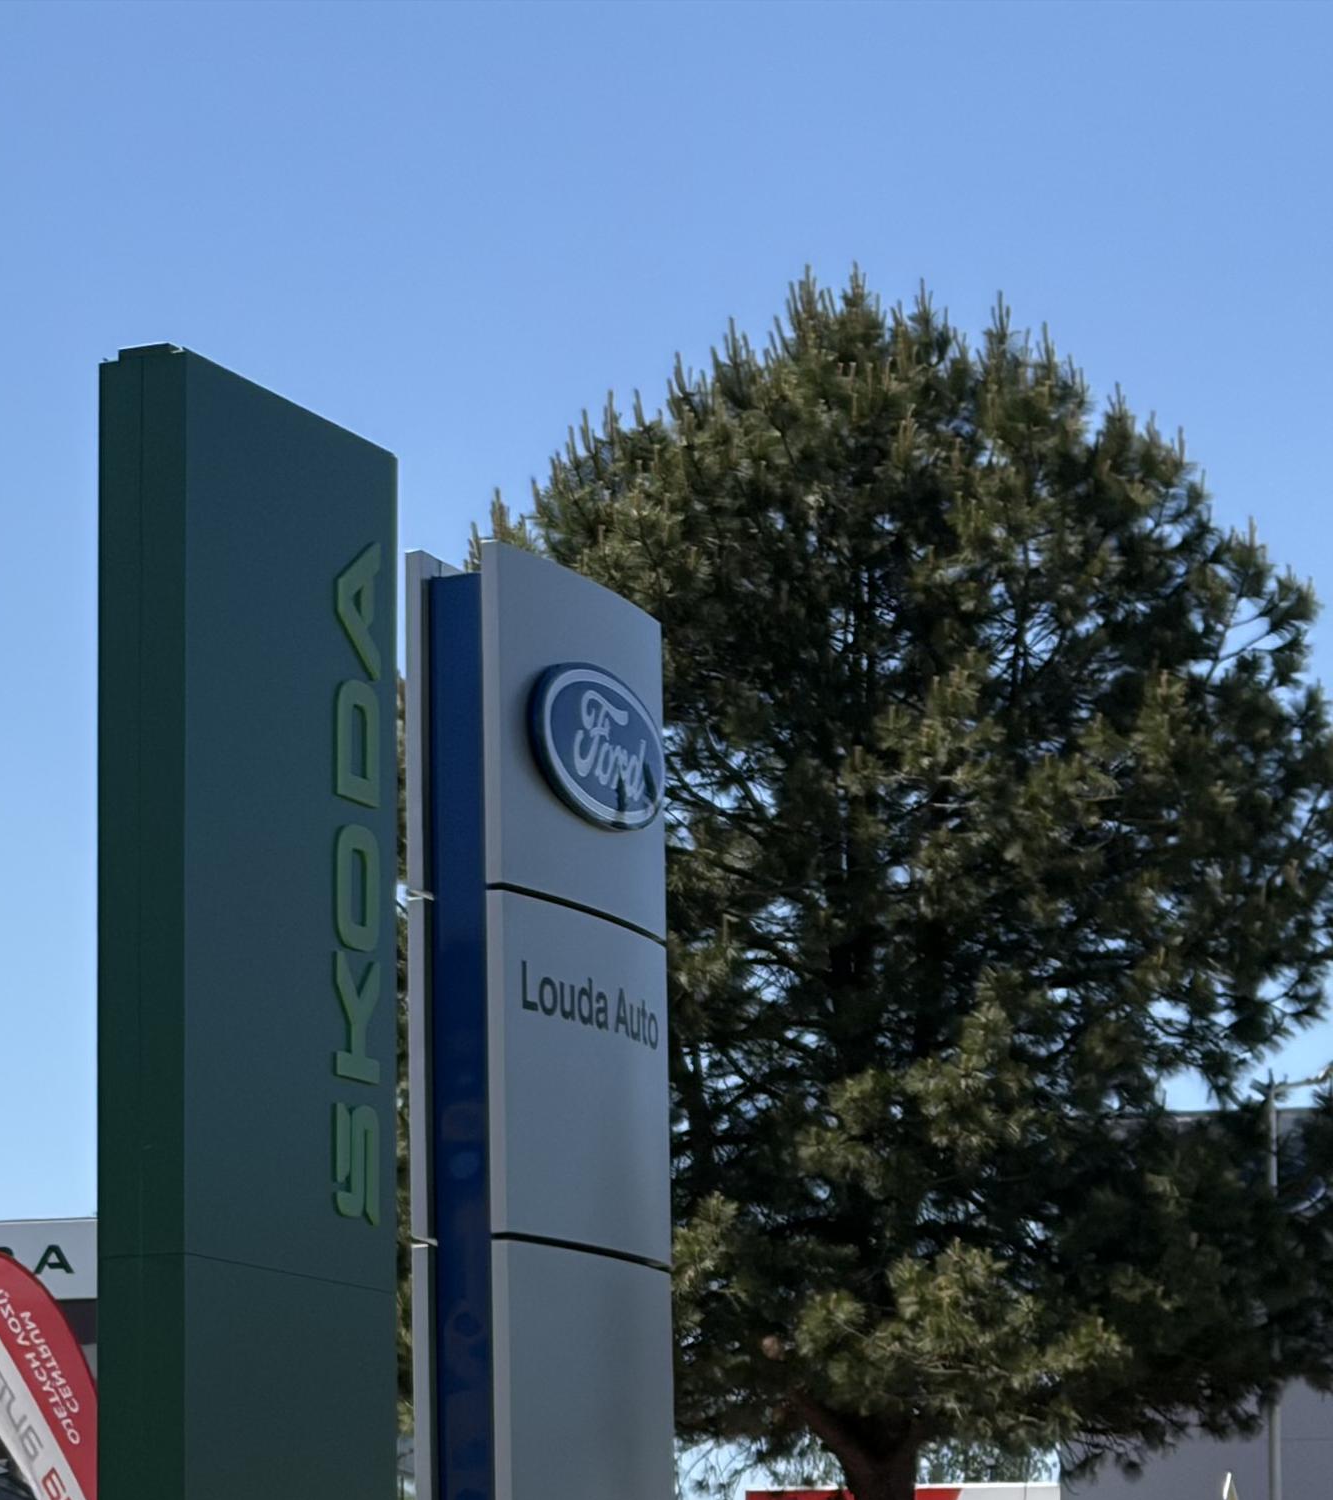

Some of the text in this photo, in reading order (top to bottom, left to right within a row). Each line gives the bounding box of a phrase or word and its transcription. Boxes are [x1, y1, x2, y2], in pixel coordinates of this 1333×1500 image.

[573, 689, 649, 802] Ford
[521, 960, 660, 1051] Louda Auto
